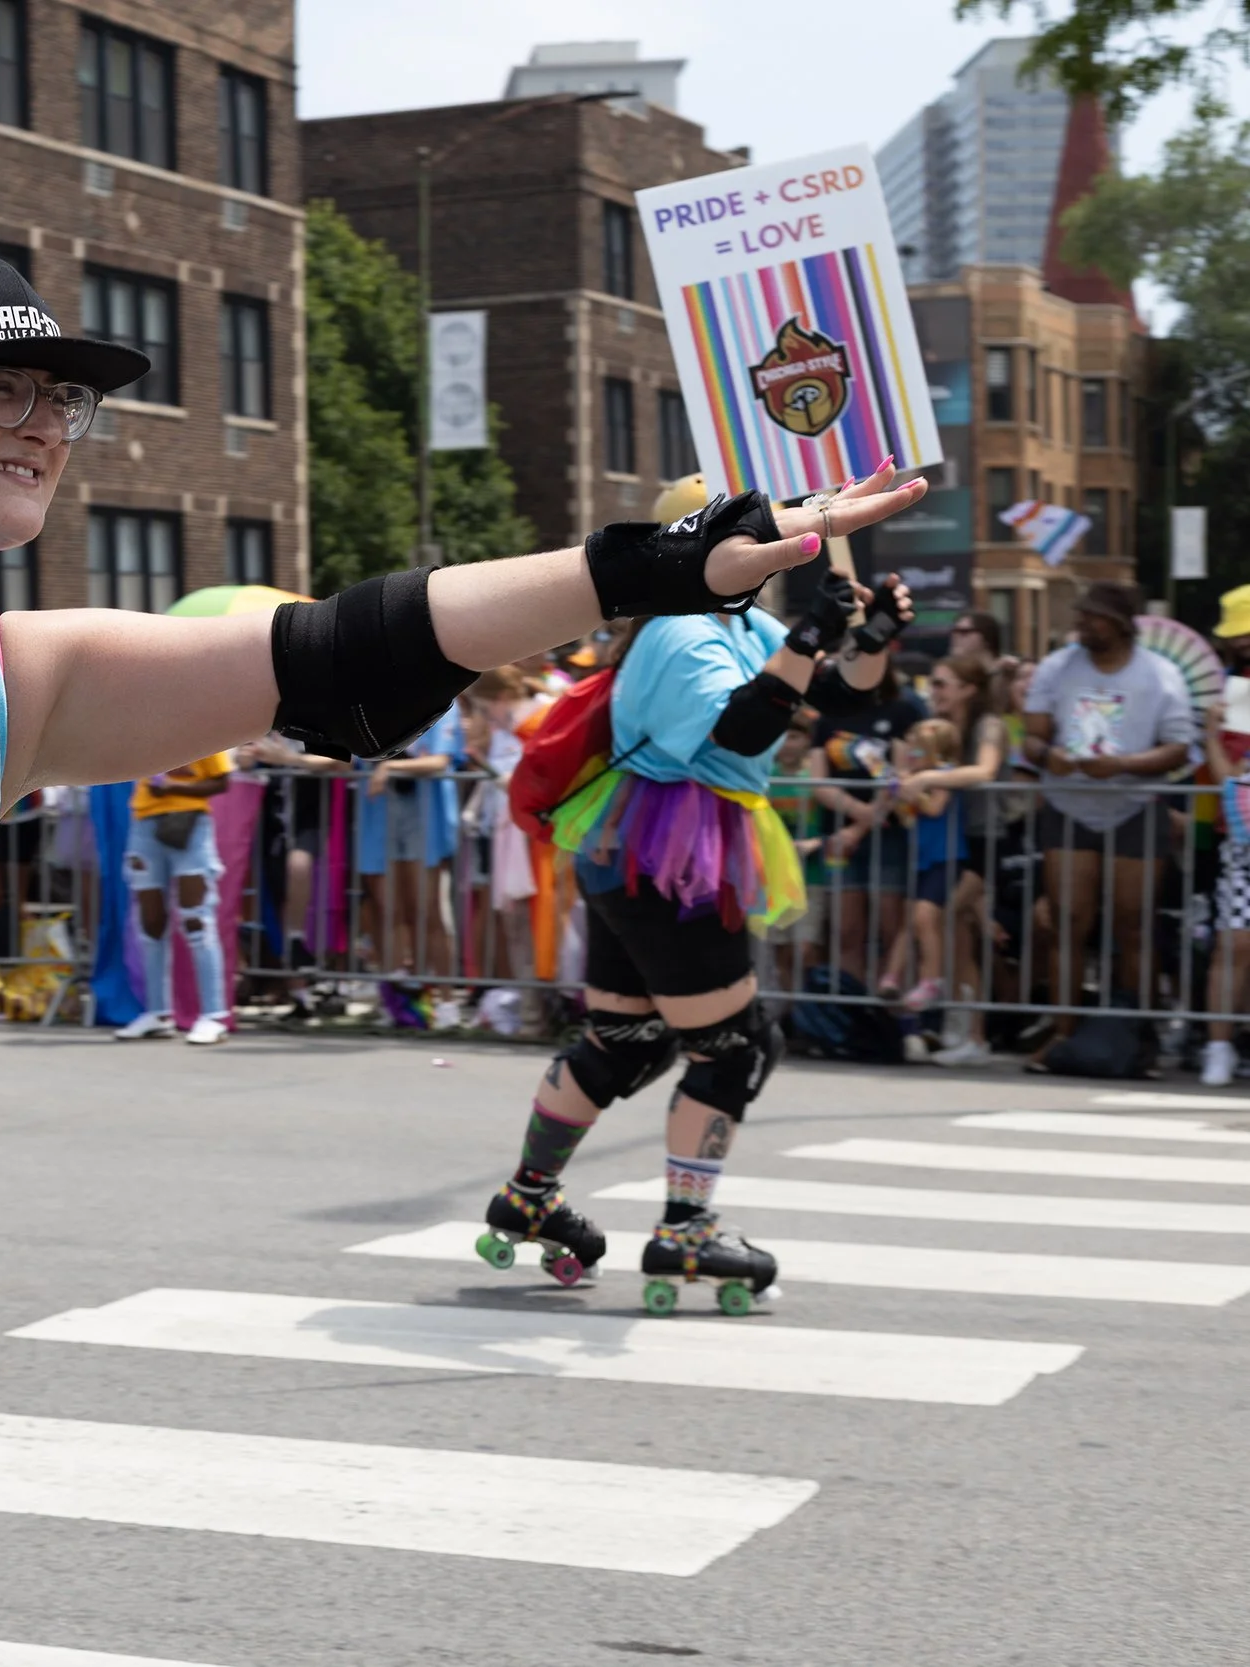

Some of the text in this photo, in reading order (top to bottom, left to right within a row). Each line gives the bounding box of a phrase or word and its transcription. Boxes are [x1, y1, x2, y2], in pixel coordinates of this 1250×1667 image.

[654, 191, 746, 233] PRIDE
[778, 164, 864, 203] CSRD
[740, 213, 825, 254] LOVE
